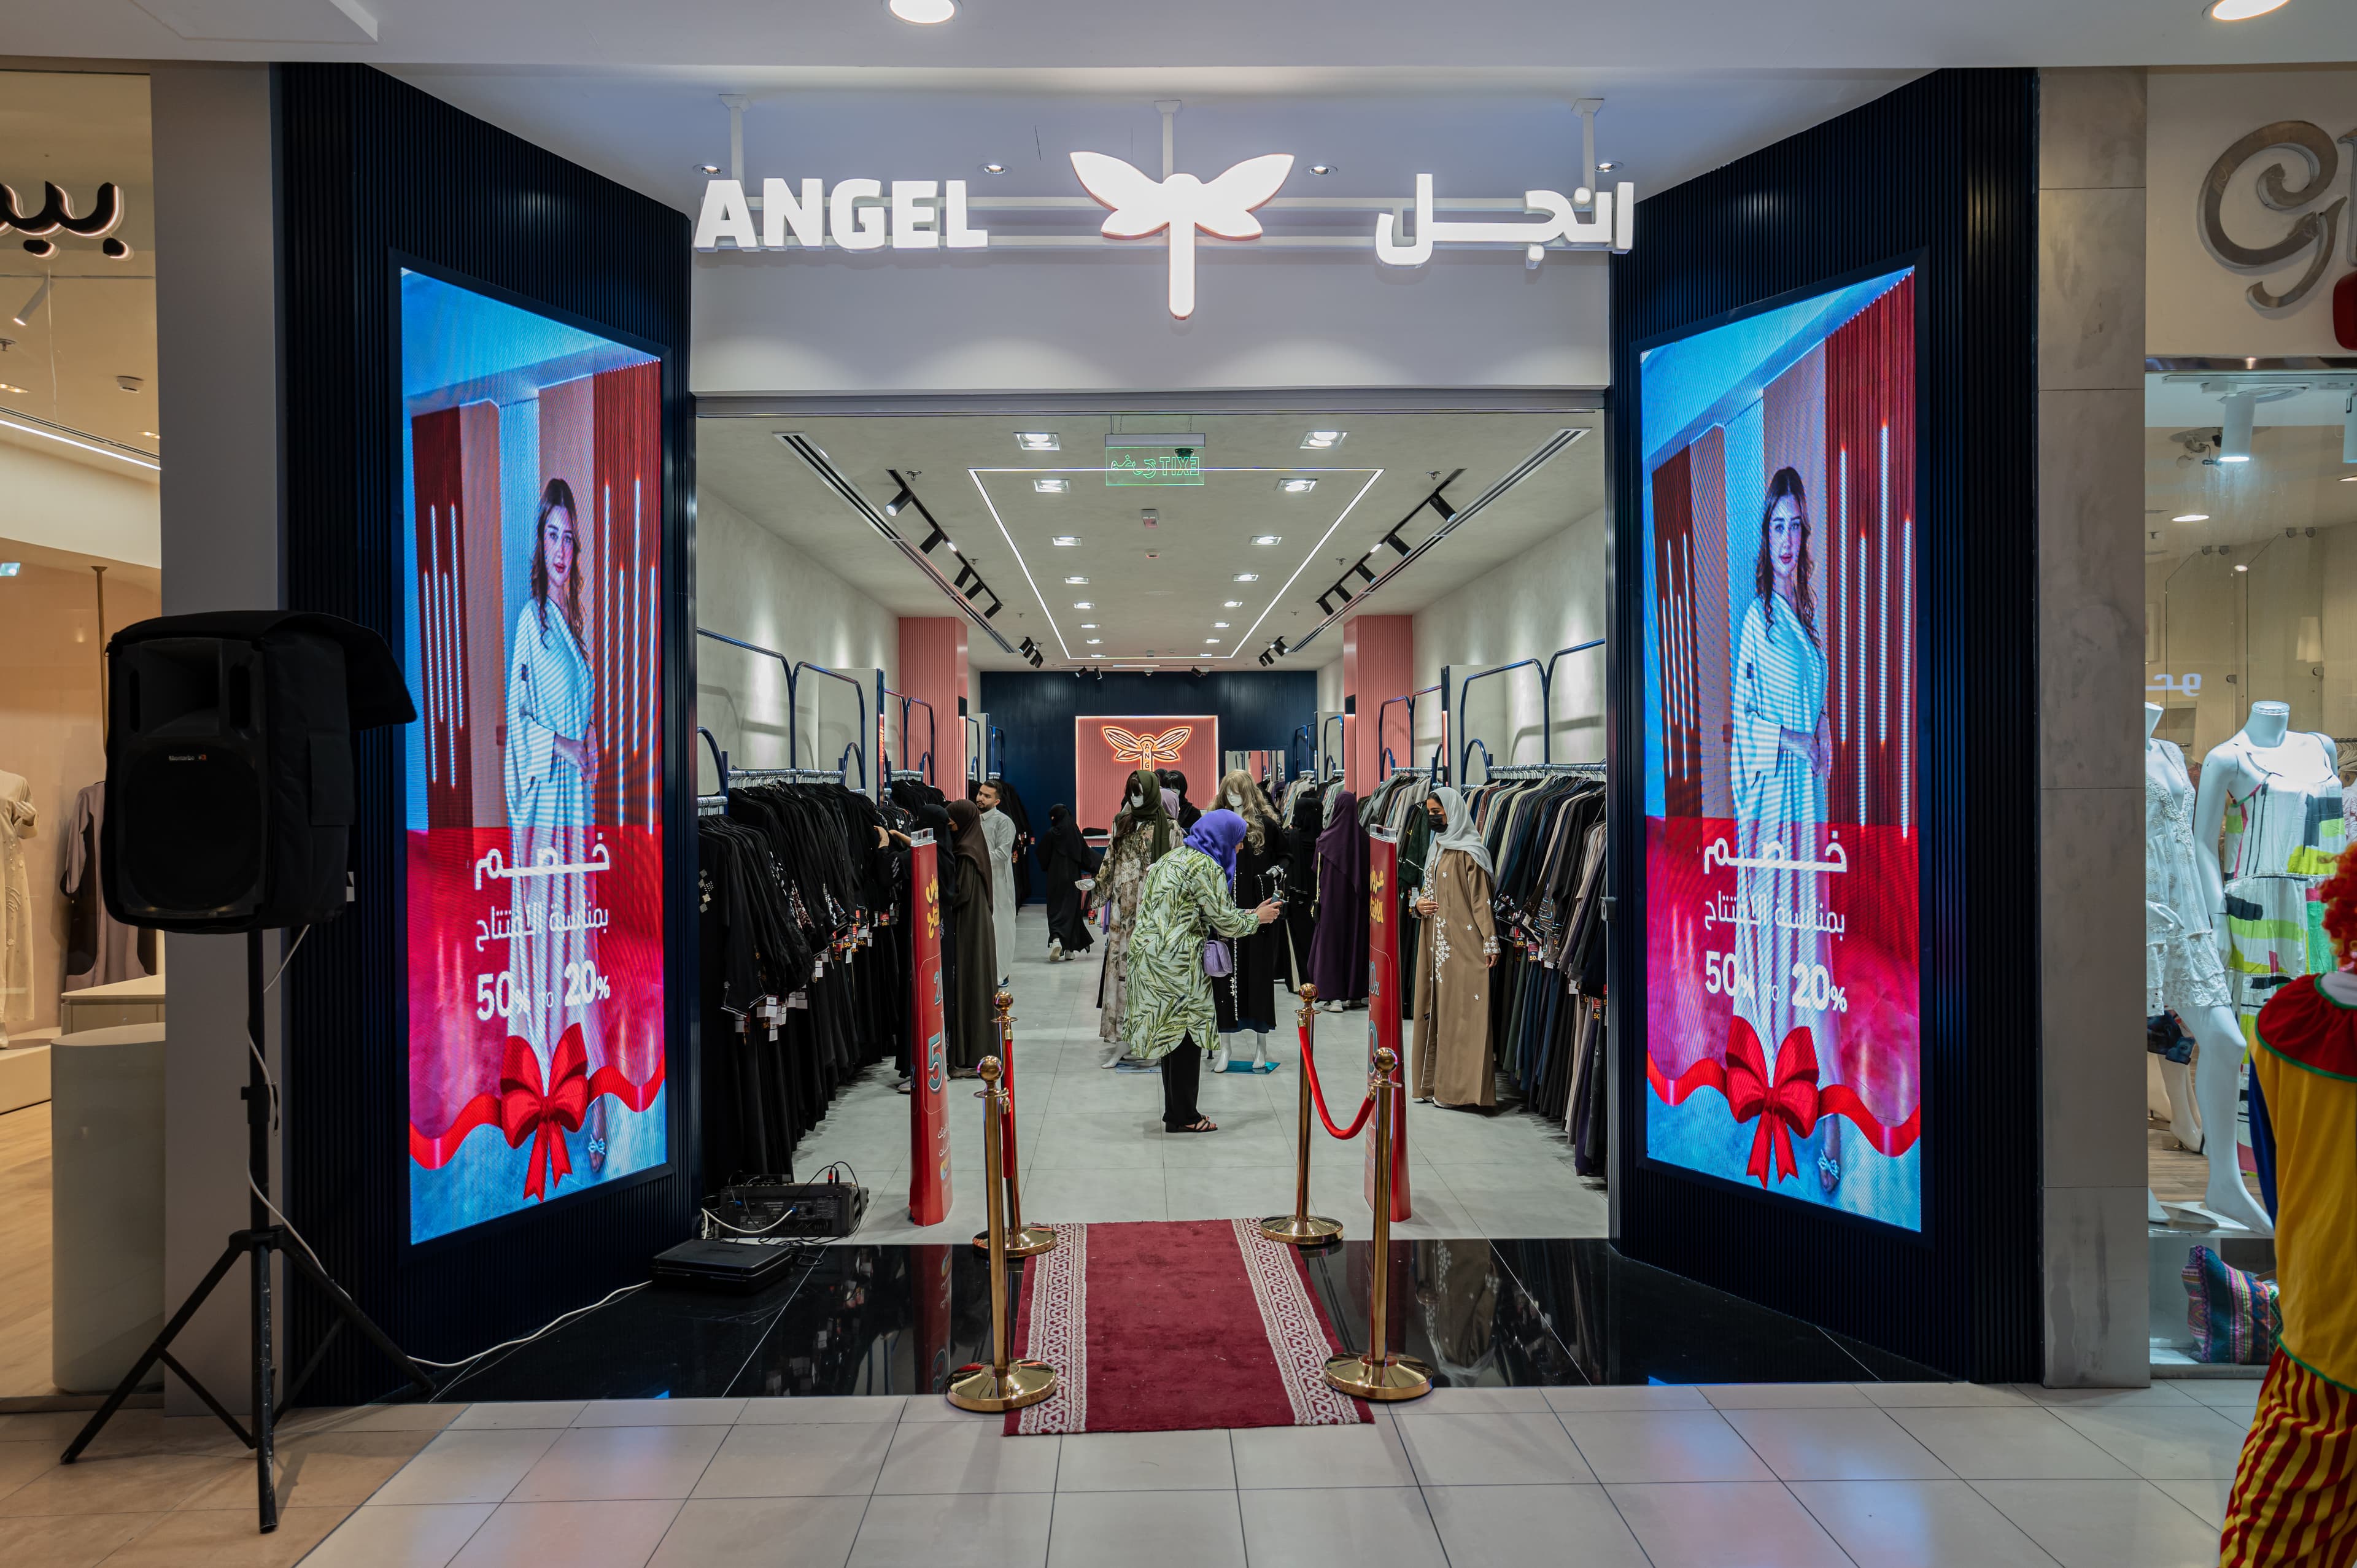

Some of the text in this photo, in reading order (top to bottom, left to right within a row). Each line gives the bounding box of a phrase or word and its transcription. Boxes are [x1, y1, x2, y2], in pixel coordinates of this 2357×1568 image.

[694, 177, 989, 250] ANGEL
[1376, 174, 1635, 268] انجل
[474, 832, 610, 890] خصم
[1704, 830, 1848, 875] خصم
[477, 971, 531, 1021] 50%
[564, 960, 610, 1007] 20%
[1705, 951, 1755, 1000] 50%
[1792, 962, 1848, 1013] 20%
